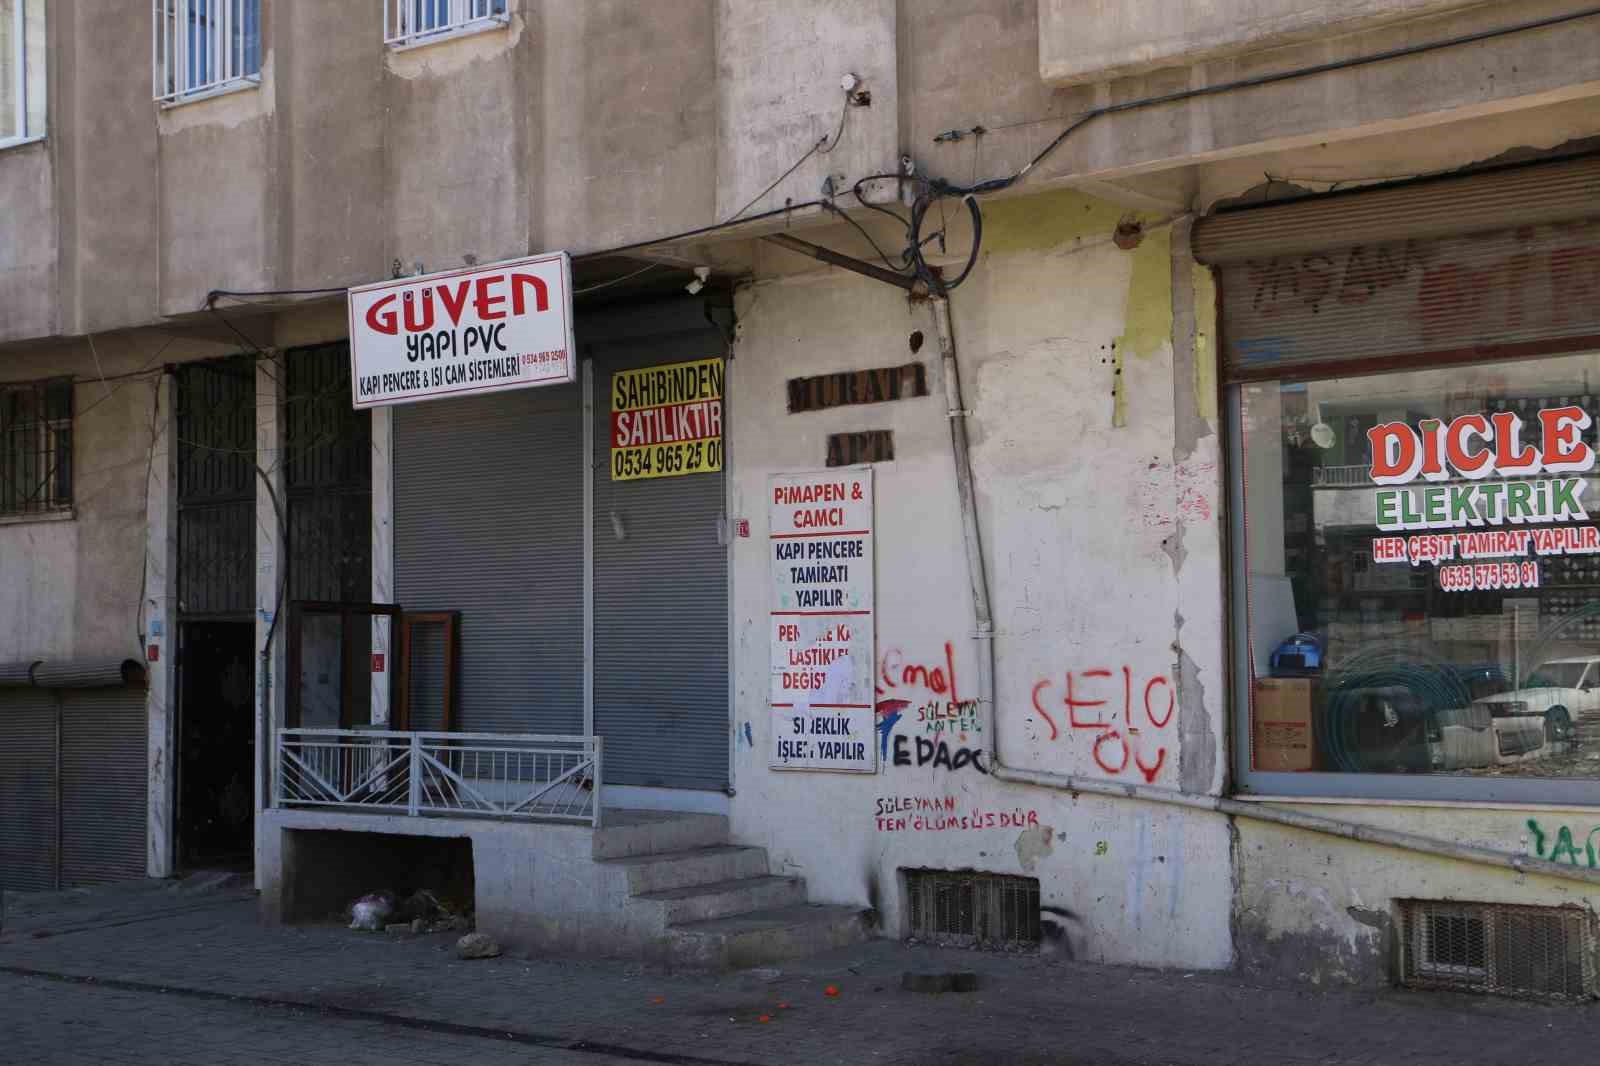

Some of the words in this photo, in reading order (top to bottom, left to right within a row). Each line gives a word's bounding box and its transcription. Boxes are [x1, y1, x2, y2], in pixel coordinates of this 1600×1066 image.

[366, 274, 549, 335] GÜVEN
[406, 329, 457, 362] YAPI
[464, 323, 506, 354] PVC
[360, 375, 380, 396] KAPI
[383, 370, 420, 393] PENCERE
[424, 370, 429, 388] &
[431, 366, 443, 387] ISI
[445, 363, 467, 385] CAM
[616, 400, 721, 447] SATILIKTIR
[615, 448, 651, 476] 0534
[657, 445, 682, 472] 965
[686, 442, 702, 469] 25
[851, 482, 863, 500] &
[793, 508, 843, 528] CAMCI
[776, 542, 804, 560] KAPI
[808, 540, 863, 559] PENCERE
[1373, 538, 1406, 562] HER
[1532, 527, 1600, 553] YAPILIR
[1440, 566, 1474, 591] 0535
[1475, 564, 1499, 590] 575
[1502, 563, 1519, 589] 53
[1521, 562, 1538, 587] 81
[795, 589, 843, 607] YAPILIR
[817, 741, 865, 761] YAPILIR
